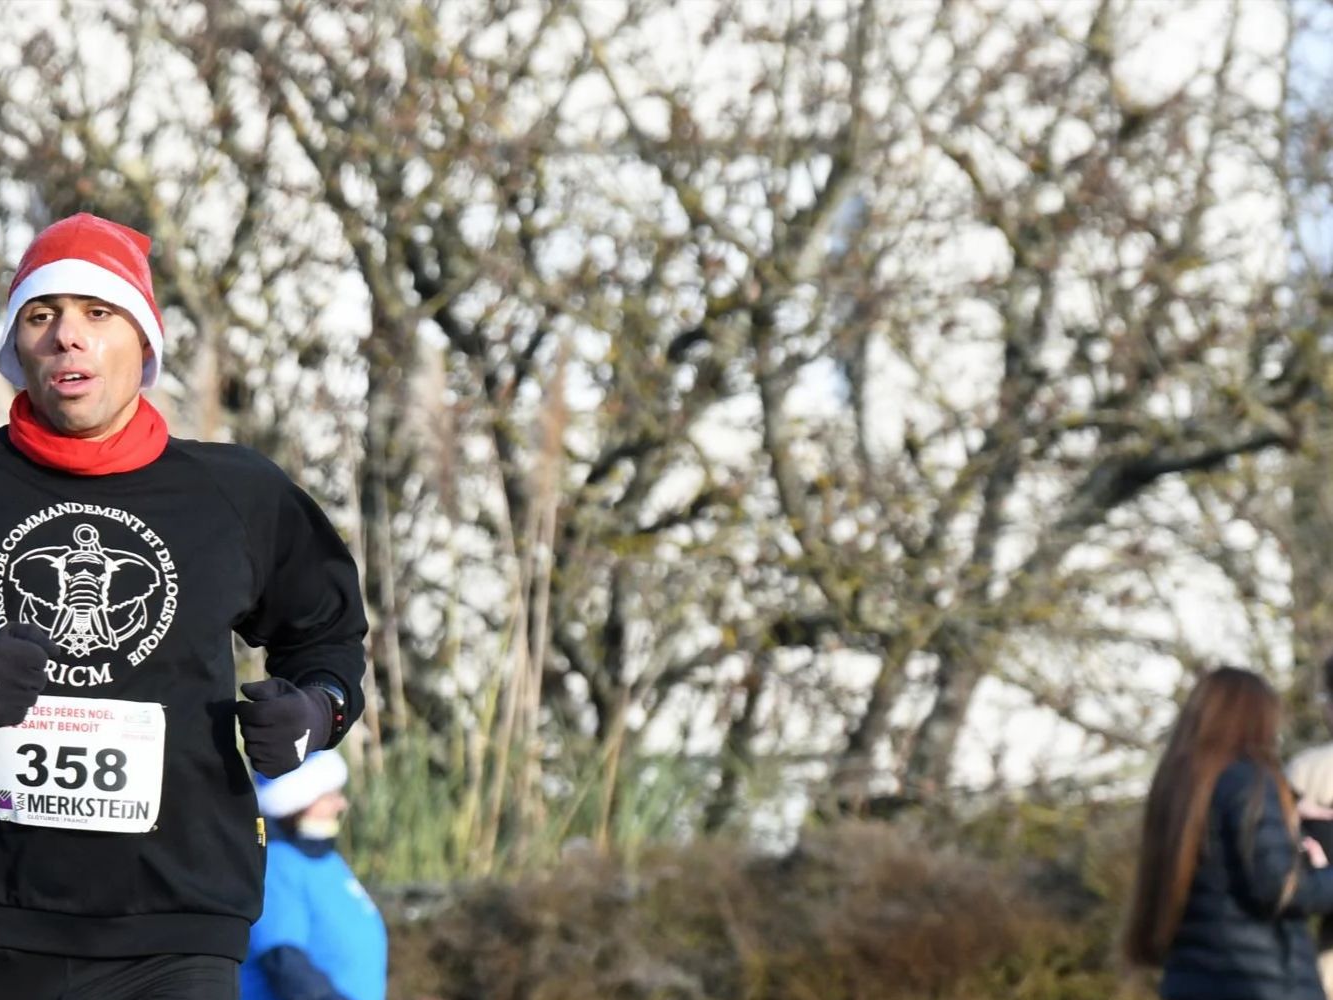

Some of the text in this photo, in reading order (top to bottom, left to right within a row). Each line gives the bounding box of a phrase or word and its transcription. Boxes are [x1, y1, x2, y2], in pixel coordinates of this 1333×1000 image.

[2, 502, 146, 551] COMMANDEMENT
[139, 527, 165, 548] ET
[155, 547, 176, 573] DE
[127, 572, 179, 667] LOGISTIQUE
[44, 659, 114, 687] RICM
[32, 706, 52, 716] DES
[21, 720, 55, 731] SAINT
[15, 743, 128, 792] 358
[15, 792, 26, 811] VAN
